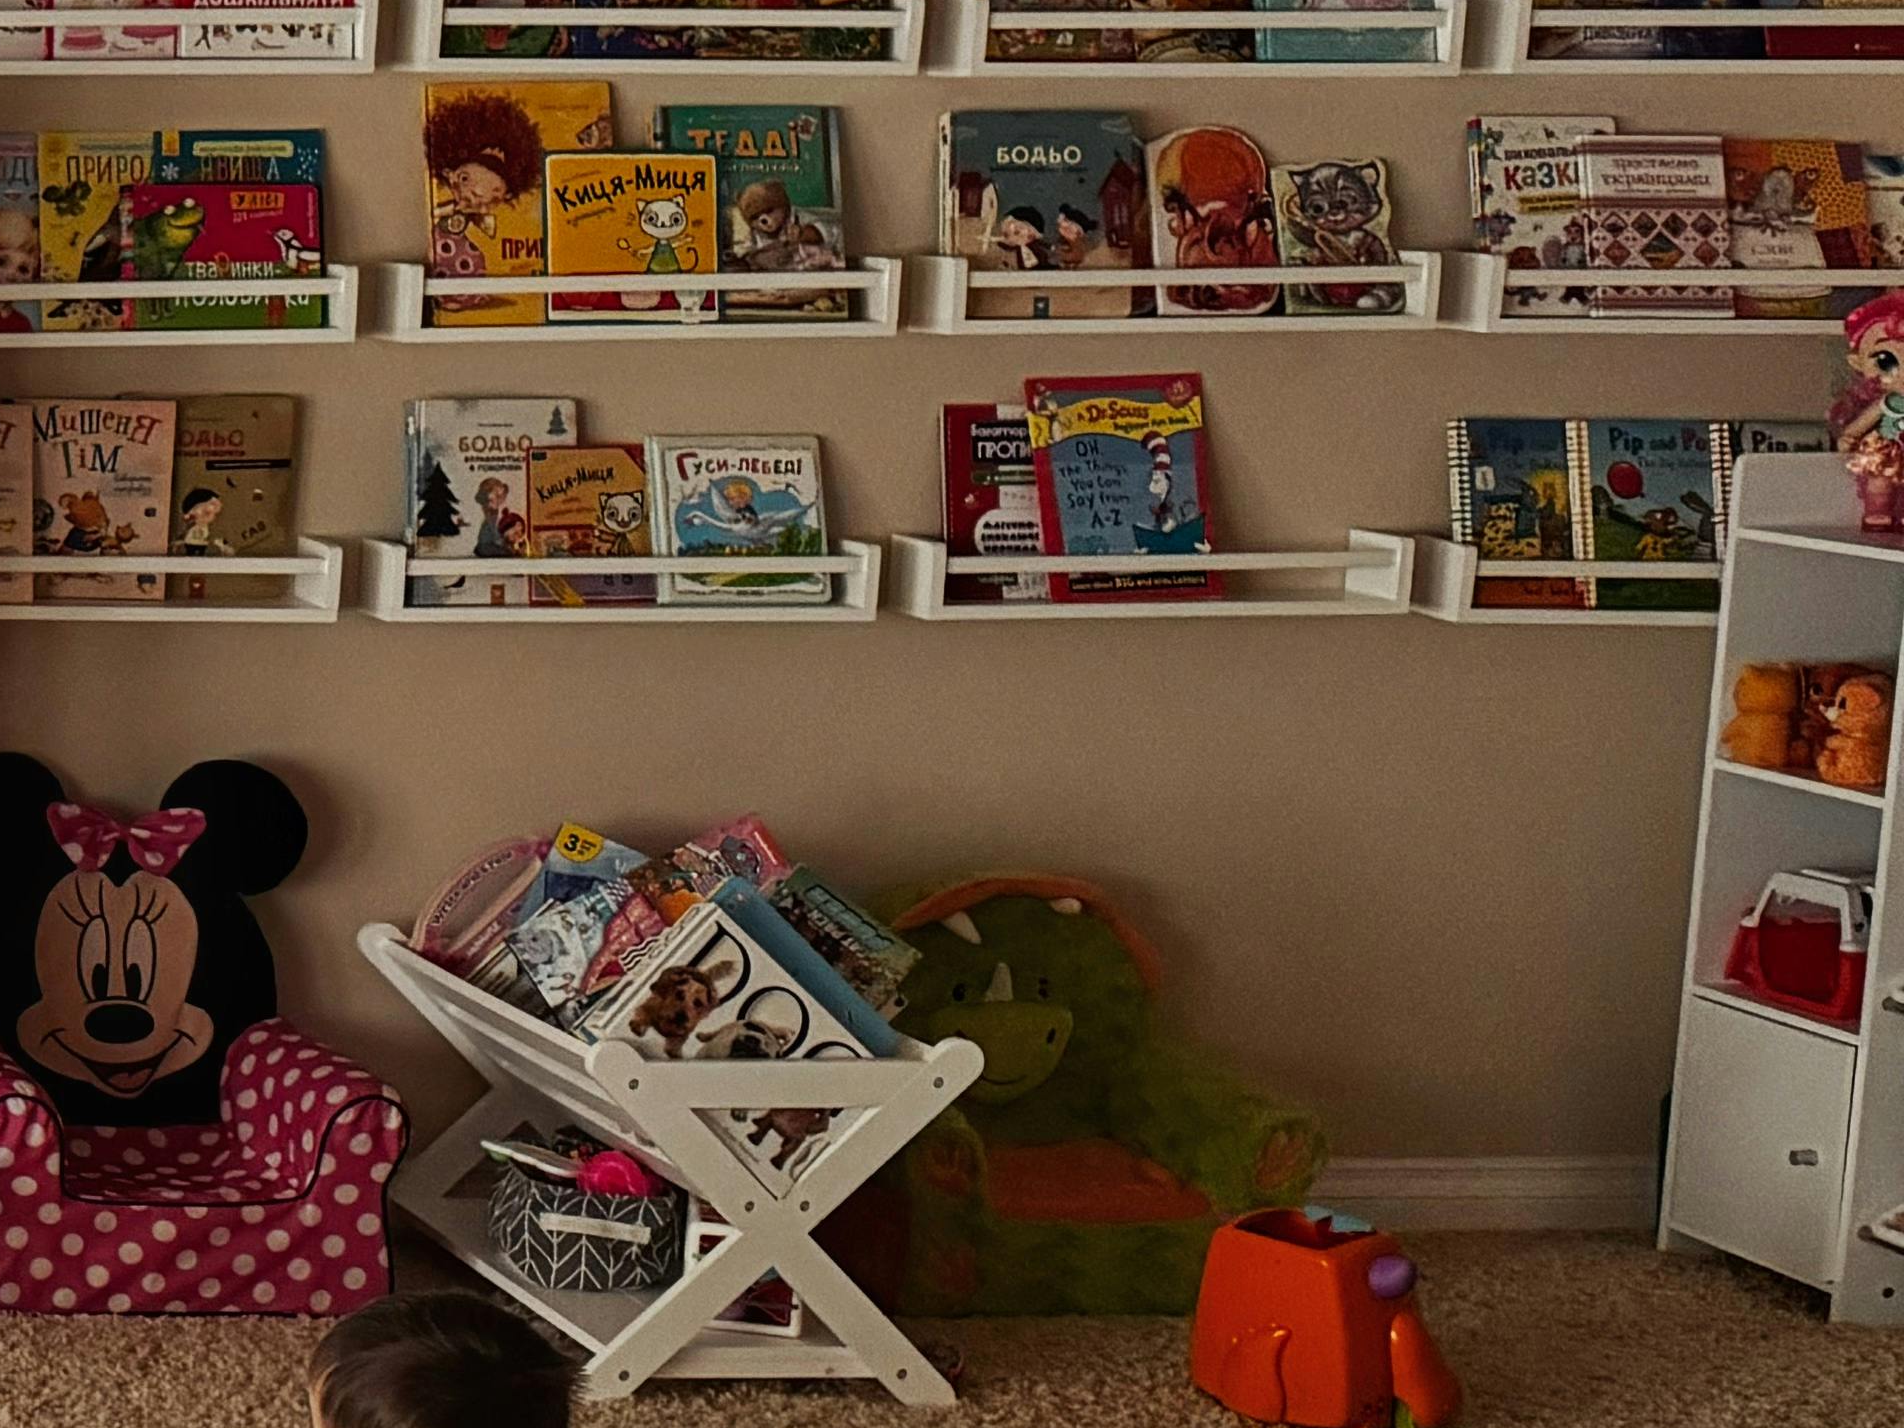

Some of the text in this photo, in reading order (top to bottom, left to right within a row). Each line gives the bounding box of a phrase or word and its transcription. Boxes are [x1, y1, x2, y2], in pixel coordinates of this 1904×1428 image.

[688, 121, 801, 158] ТЕДДІ
[996, 145, 1082, 165] БОДЬО
[553, 164, 707, 213] Киця-Миця
[178, 429, 245, 448] ОДЬО
[458, 435, 534, 454] БОДЬО
[1608, 427, 1645, 454] Pip
[977, 440, 1032, 459] ПРОПИ
[564, 833, 580, 852] 3
